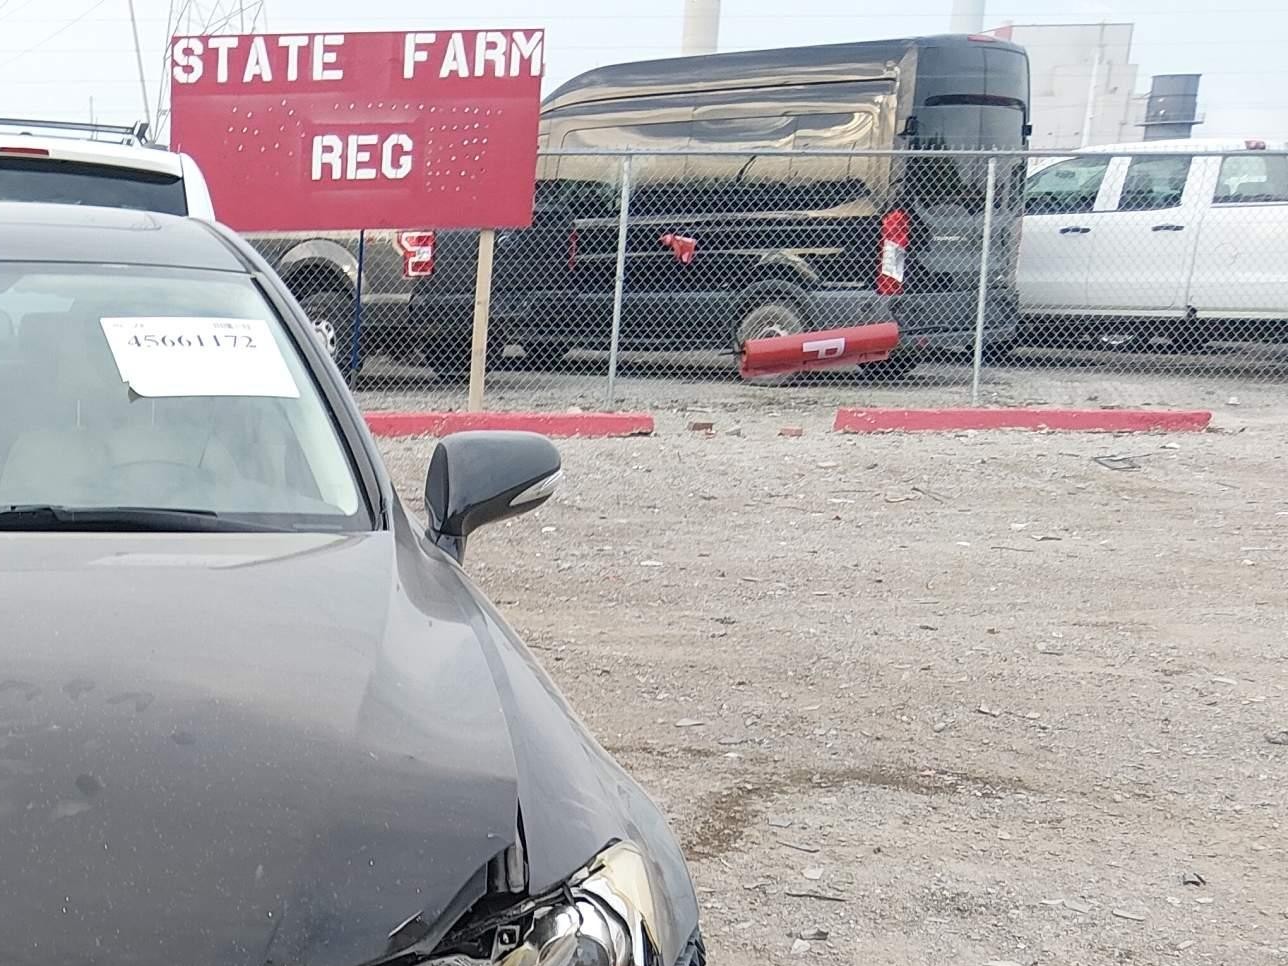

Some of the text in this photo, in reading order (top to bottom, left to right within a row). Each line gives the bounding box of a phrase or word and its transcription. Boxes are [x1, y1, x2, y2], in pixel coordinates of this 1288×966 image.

[172, 31, 544, 83] STATE FARM
[312, 134, 413, 180] REG
[128, 335, 257, 348] 45661172
